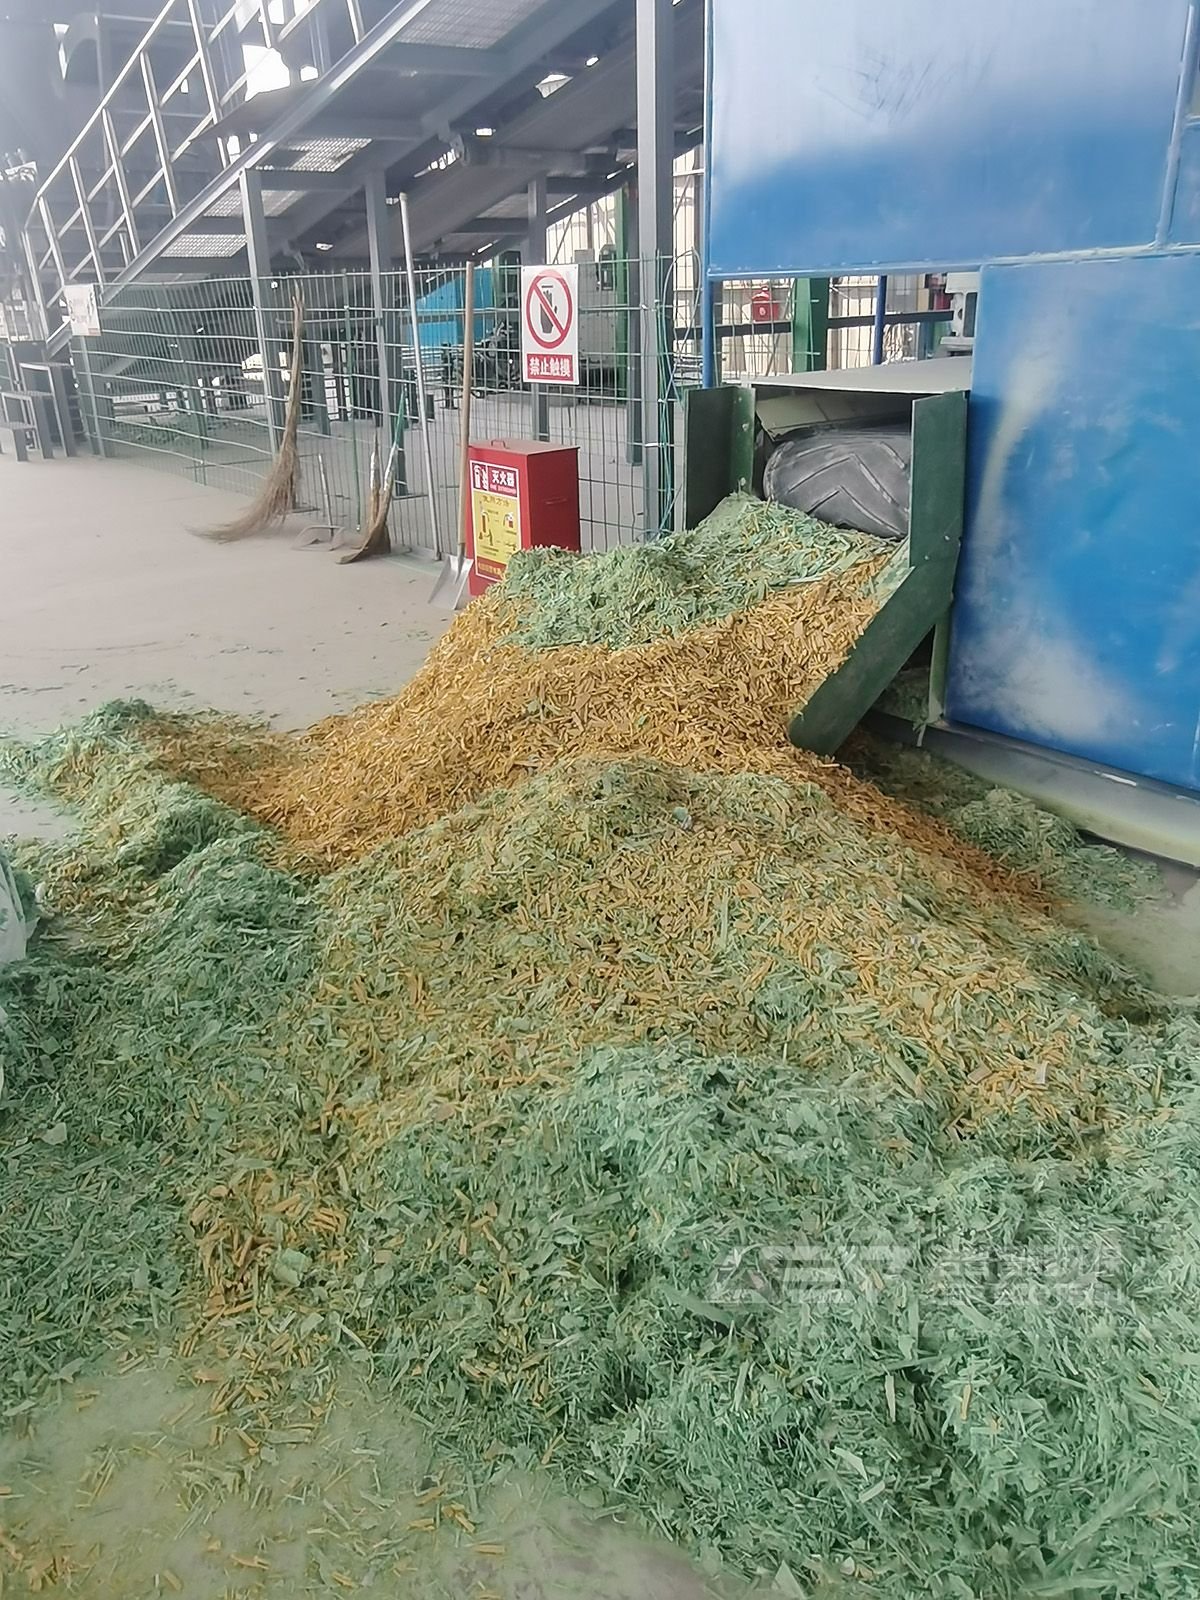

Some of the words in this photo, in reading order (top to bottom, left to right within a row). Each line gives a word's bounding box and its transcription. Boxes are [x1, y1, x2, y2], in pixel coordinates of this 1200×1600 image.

[530, 356, 571, 377] 禁止触摸
[491, 469, 515, 487] 灭火器
